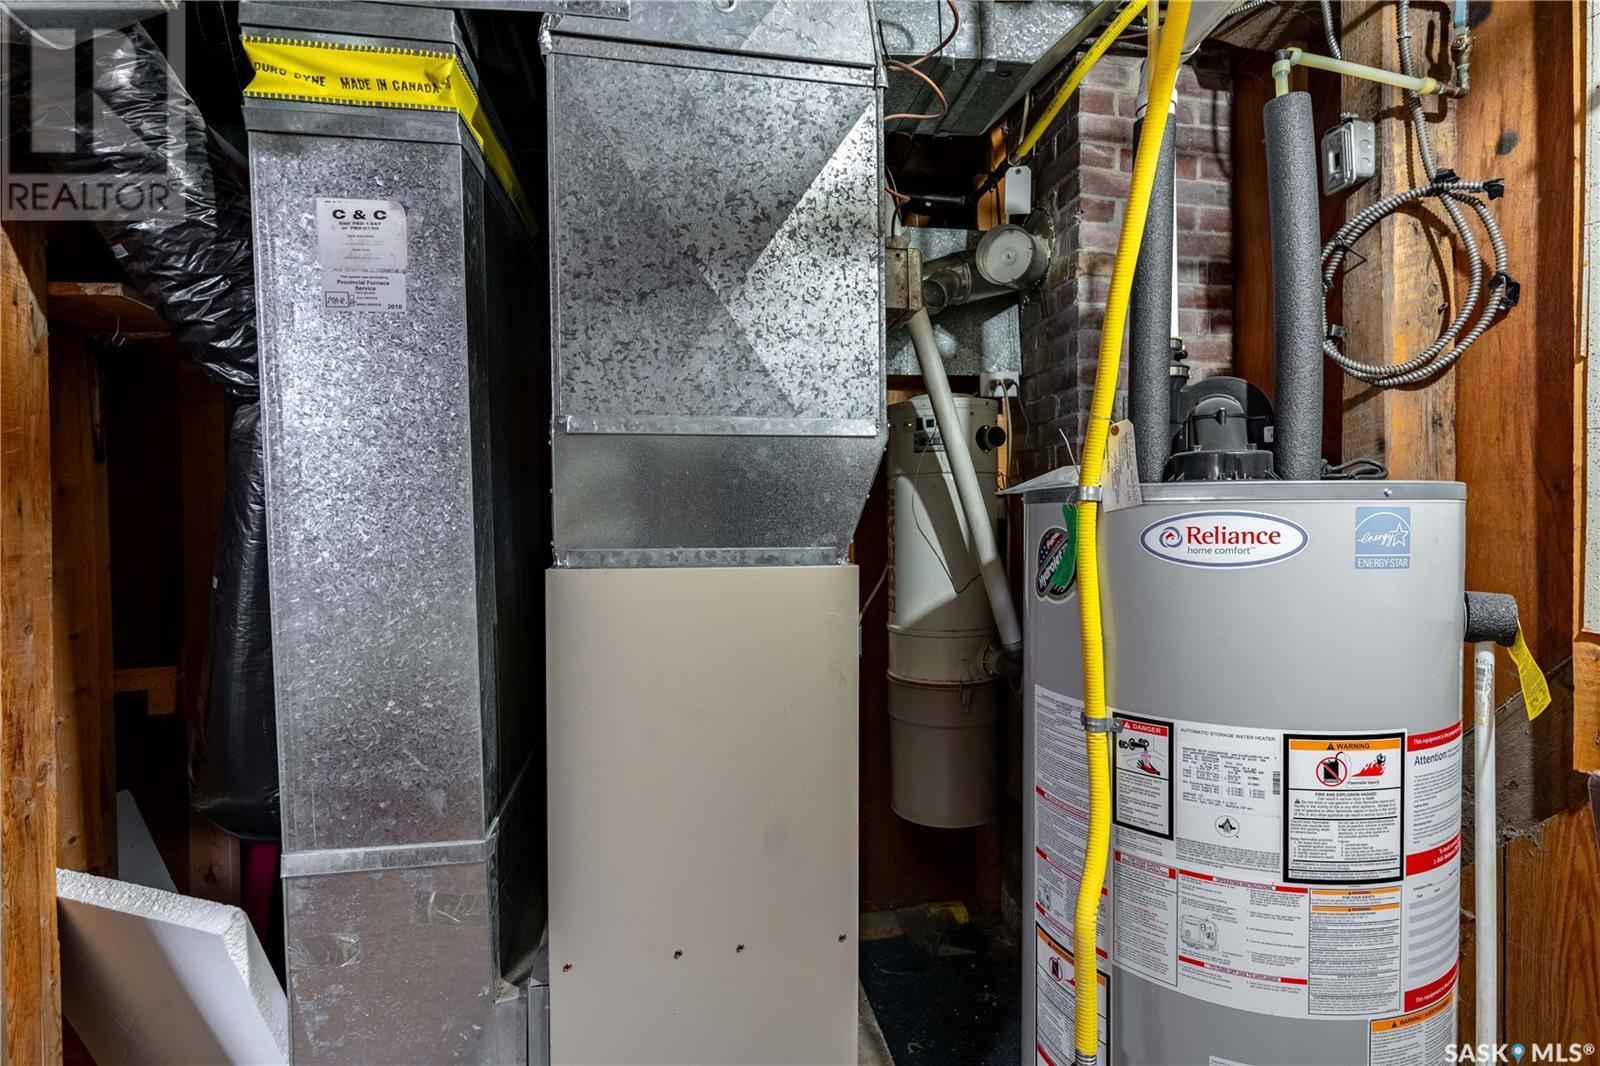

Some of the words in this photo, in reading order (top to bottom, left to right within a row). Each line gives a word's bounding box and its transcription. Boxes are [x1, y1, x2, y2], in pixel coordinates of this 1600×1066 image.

[254, 62, 287, 76] DURO
[294, 72, 326, 87] DYNE
[340, 77, 372, 91] MADE
[376, 78, 388, 91] IN
[392, 80, 440, 94] CANADA
[332, 209, 346, 219] C
[353, 209, 366, 219] &
[373, 210, 387, 220] C
[1185, 526, 1281, 545] Reliance
[1187, 546, 1213, 555] home
[1358, 558, 1388, 569] ENERGY
[1389, 558, 1409, 569] STAR
[1132, 723, 1161, 734] DANGER
[1180, 728, 1209, 736] AUTOMATIC
[1210, 731, 1234, 739] STORAGE
